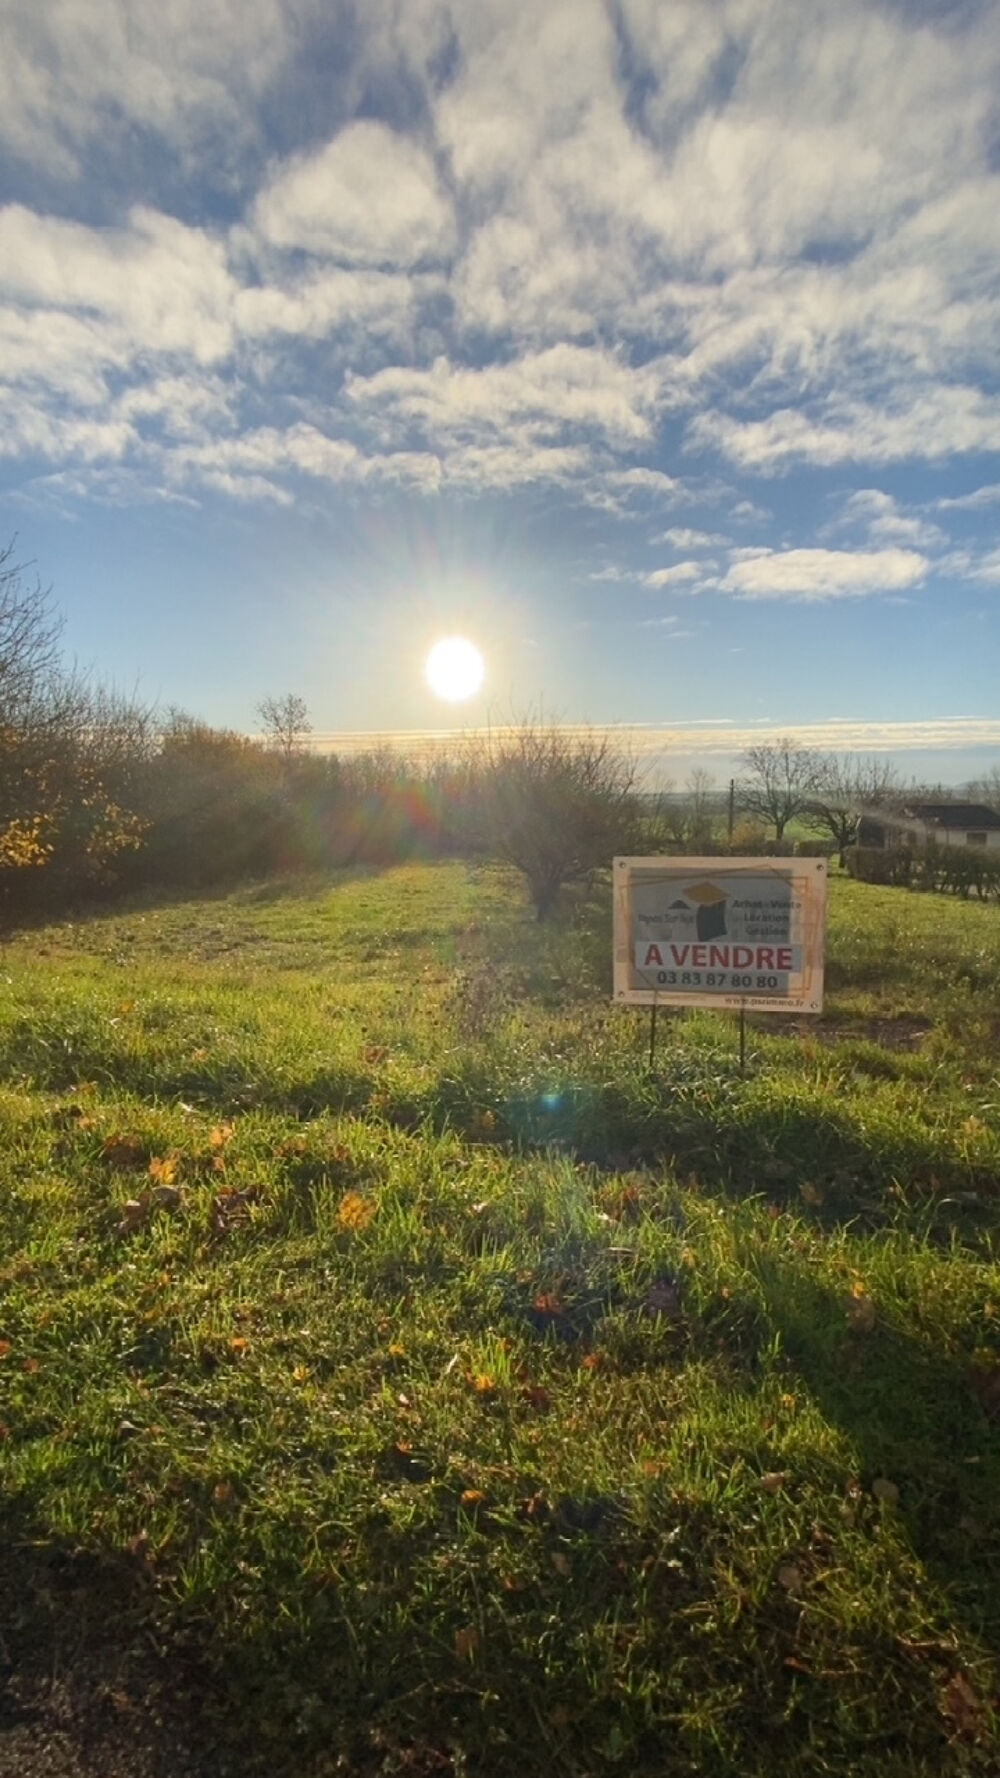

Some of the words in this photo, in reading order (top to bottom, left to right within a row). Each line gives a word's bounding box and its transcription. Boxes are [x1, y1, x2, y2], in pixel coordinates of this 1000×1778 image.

[644, 944, 663, 966] A
[670, 945, 793, 970] VENDRE
[657, 971, 676, 985] 03
[681, 972, 701, 985] 83
[706, 972, 726, 986] 87
[731, 974, 751, 987] 80
[757, 975, 777, 988] 80
